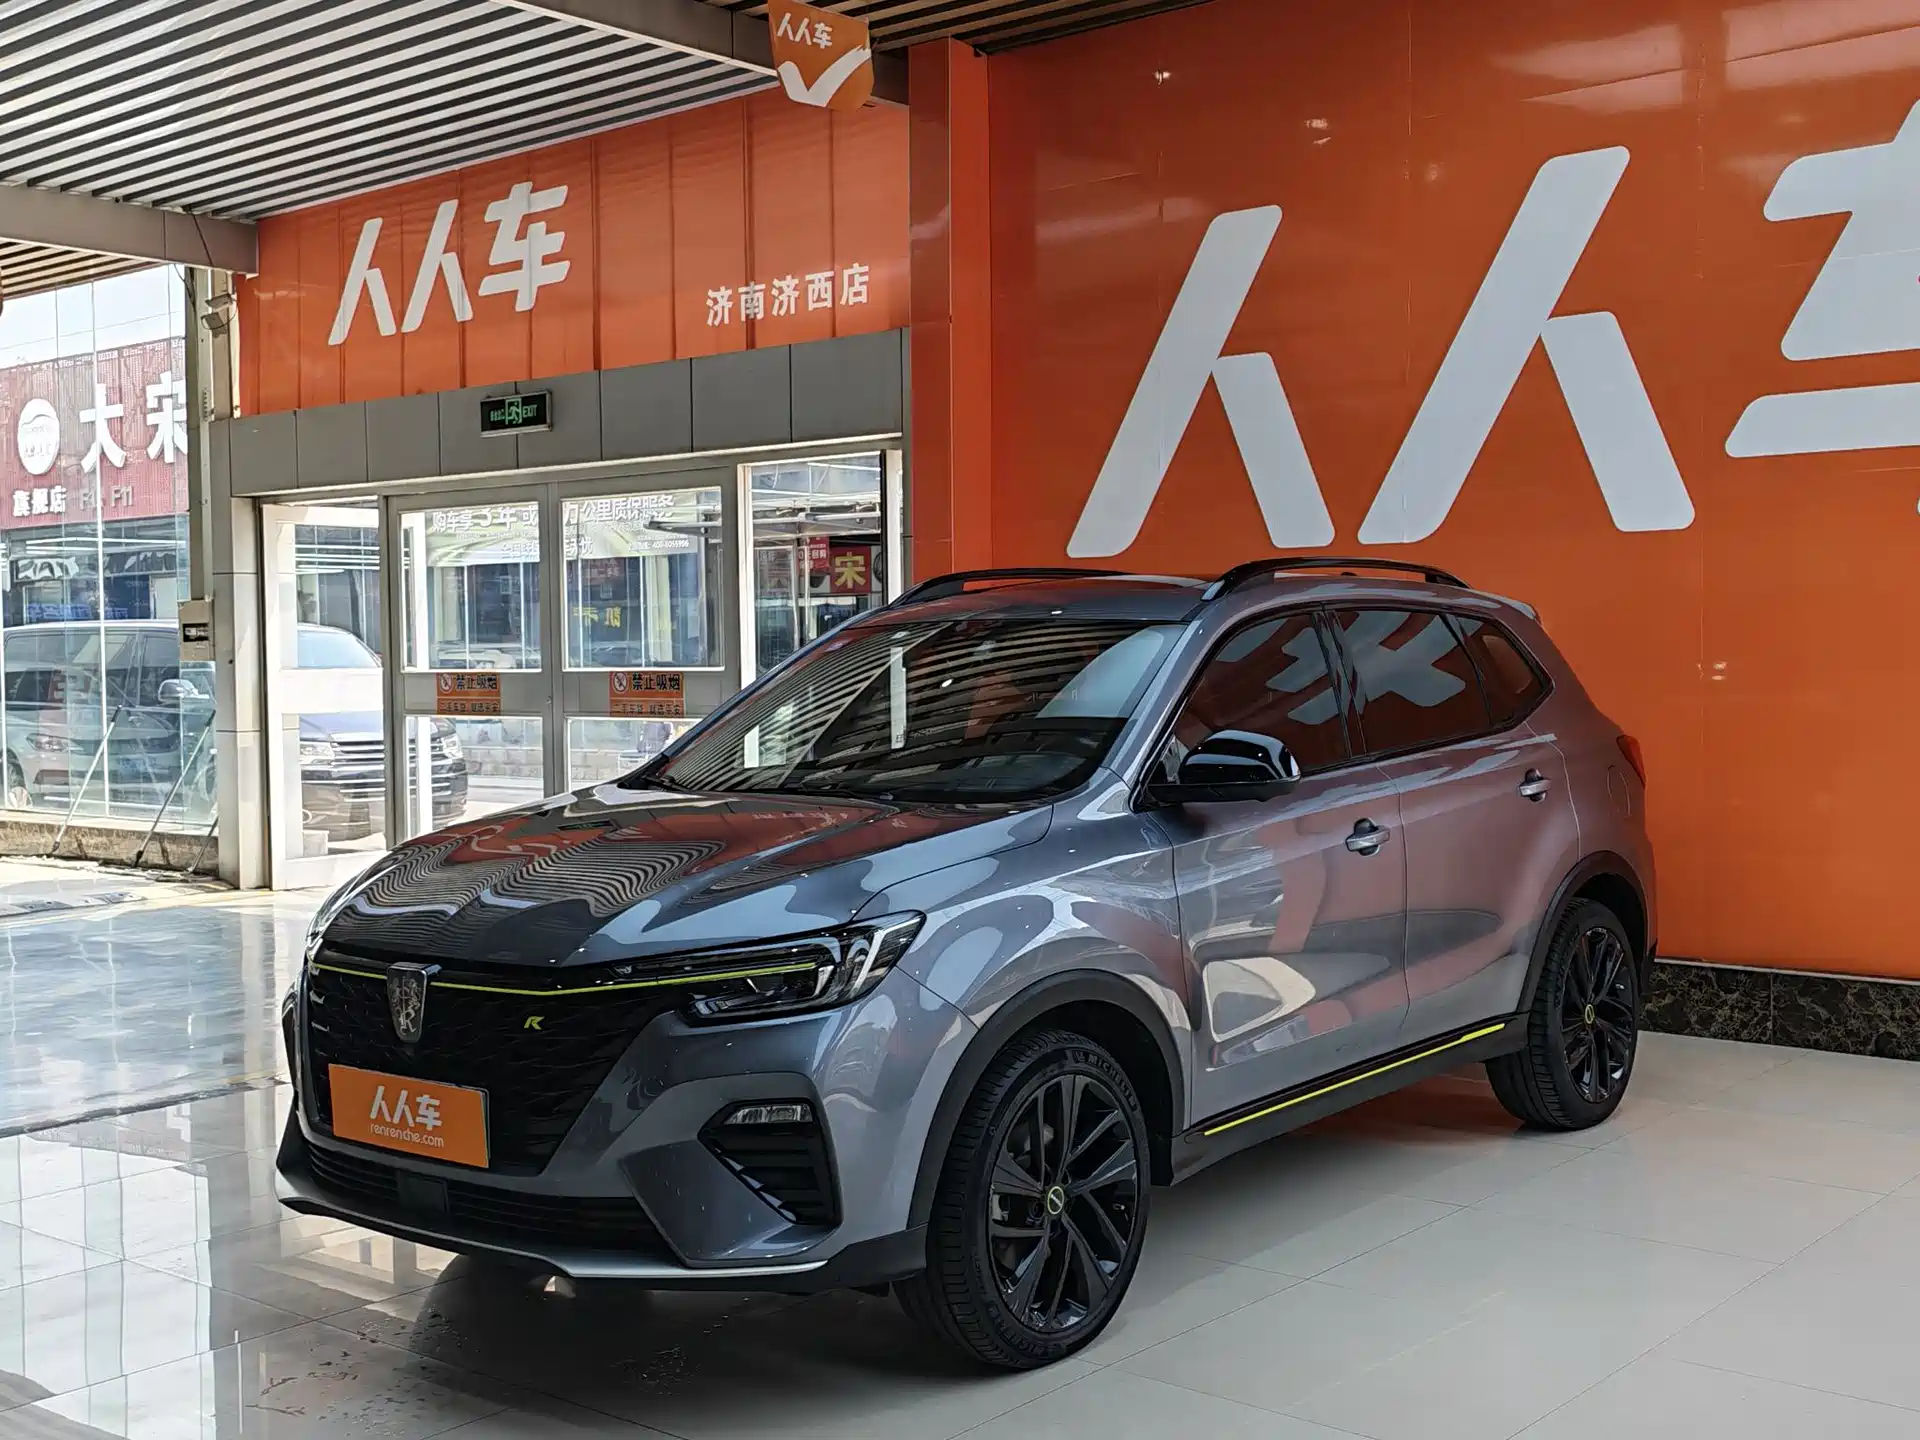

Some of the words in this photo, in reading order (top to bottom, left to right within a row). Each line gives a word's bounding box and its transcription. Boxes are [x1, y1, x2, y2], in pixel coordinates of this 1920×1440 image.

[776, 12, 833, 49] 人人车
[327, 181, 571, 346] 人人车
[706, 262, 869, 327] 济南济西店
[835, 551, 866, 589] 宋
[456, 674, 498, 690] 禁止吸烟
[632, 672, 681, 691] 禁止吸烟
[369, 1085, 442, 1131] 人人车
[369, 1123, 445, 1149] renrenche.com
